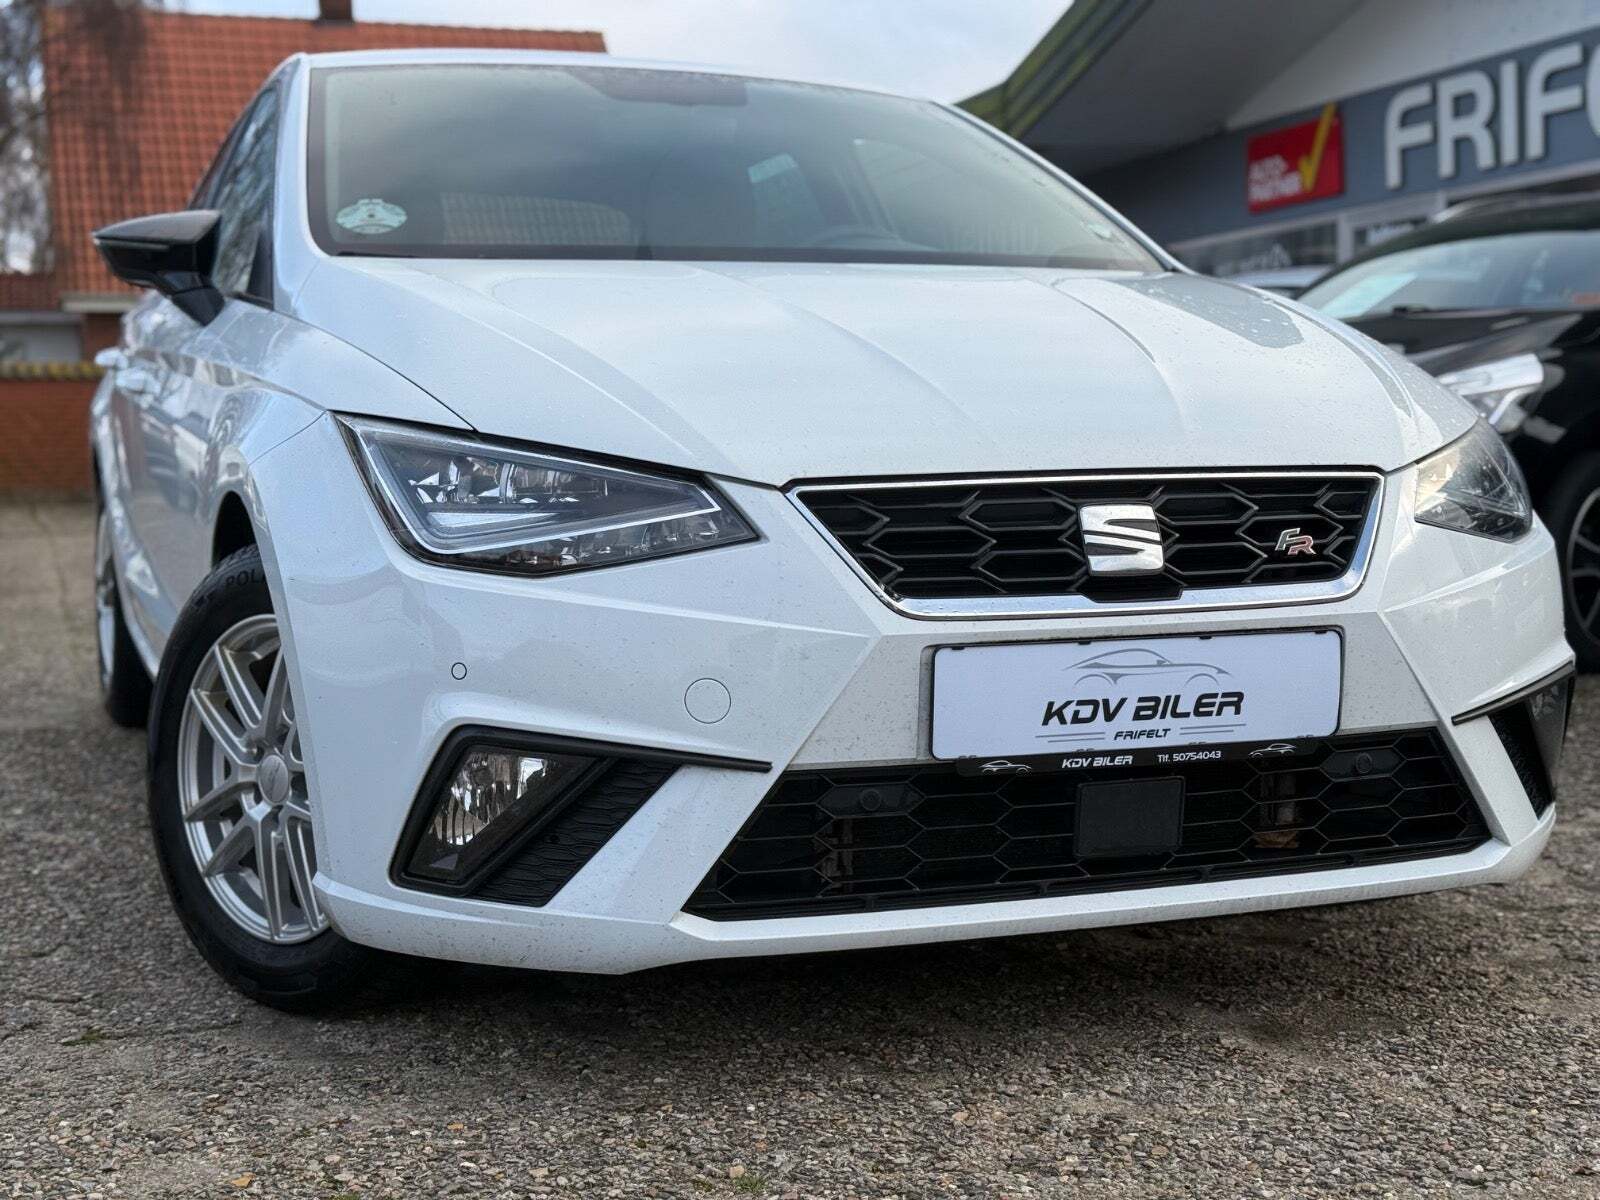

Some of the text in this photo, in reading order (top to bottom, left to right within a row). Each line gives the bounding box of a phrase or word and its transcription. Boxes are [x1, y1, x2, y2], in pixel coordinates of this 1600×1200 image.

[1385, 42, 1600, 191] FRIF
[1275, 527, 1317, 555] FR
[1041, 691, 1245, 726] KDV BILER
[1113, 728, 1171, 741] FRIFELT
[1061, 755, 1133, 769] KDV BILER
[1172, 750, 1222, 762] 50754043
